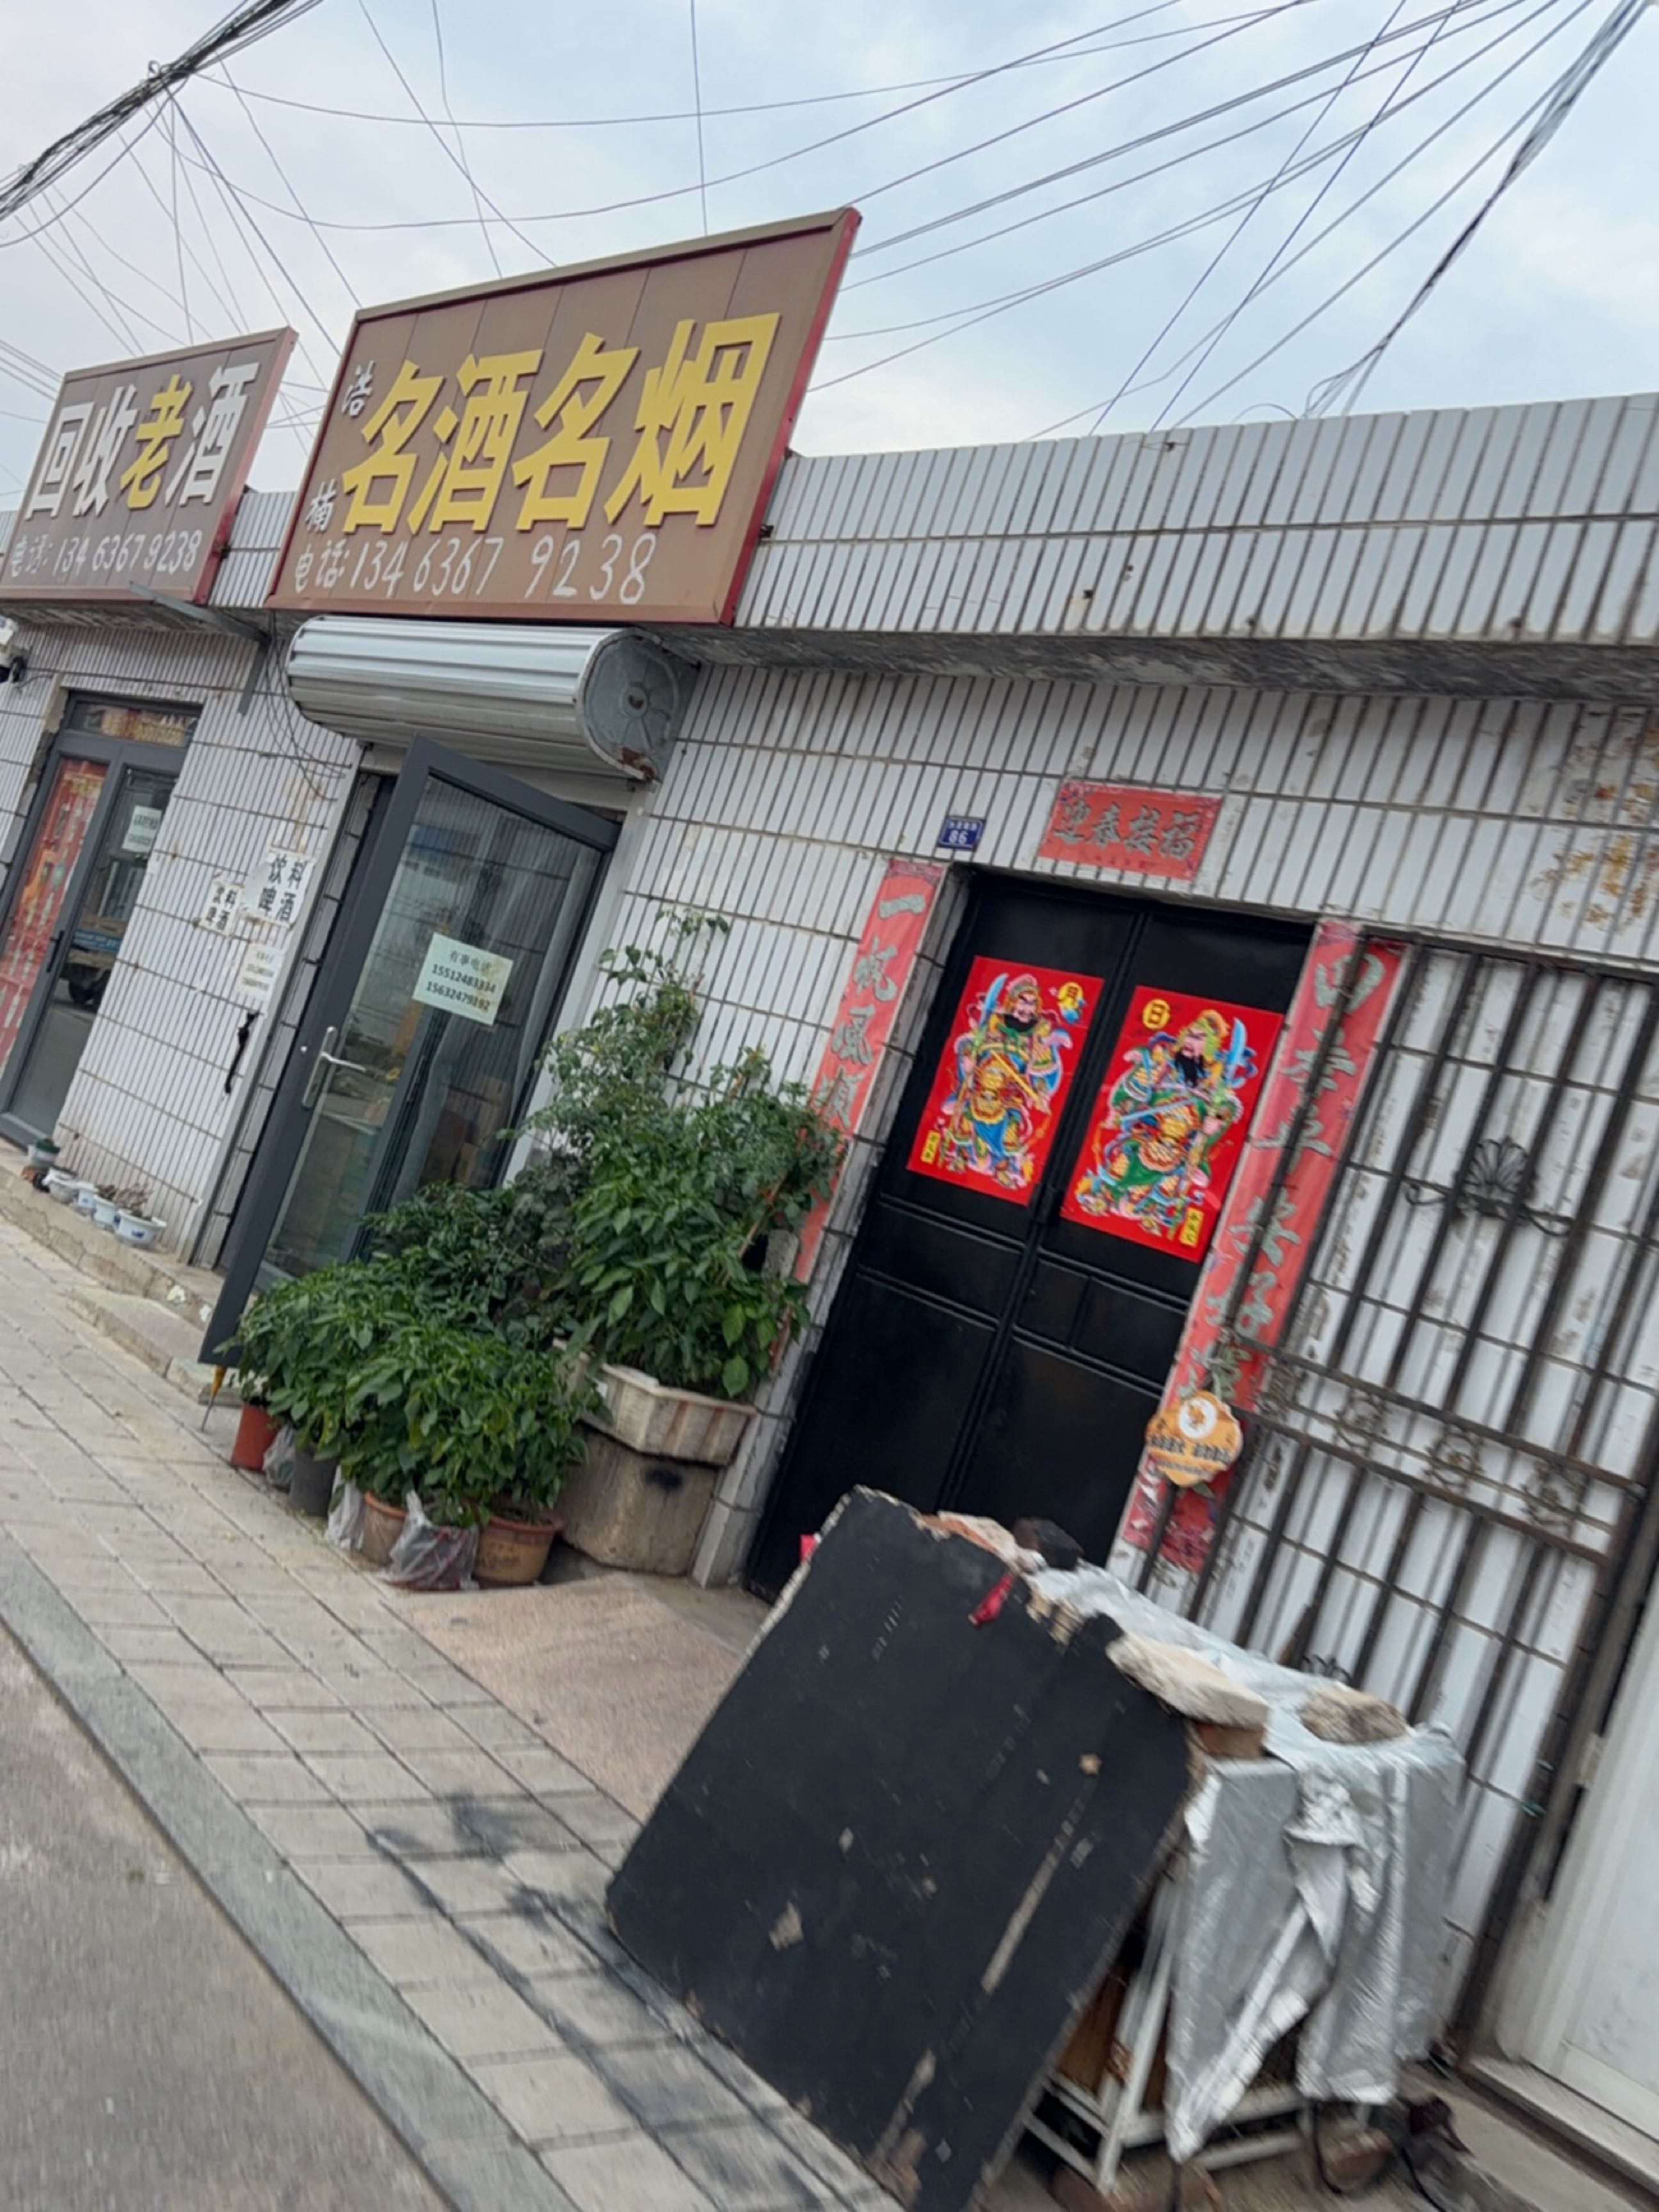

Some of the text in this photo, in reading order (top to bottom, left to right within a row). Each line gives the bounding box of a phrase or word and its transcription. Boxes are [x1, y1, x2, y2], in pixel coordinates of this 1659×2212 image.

[26, 362, 260, 521] 回收老酒
[342, 312, 781, 535] 名酒名烟
[524, 533, 657, 605] 9238
